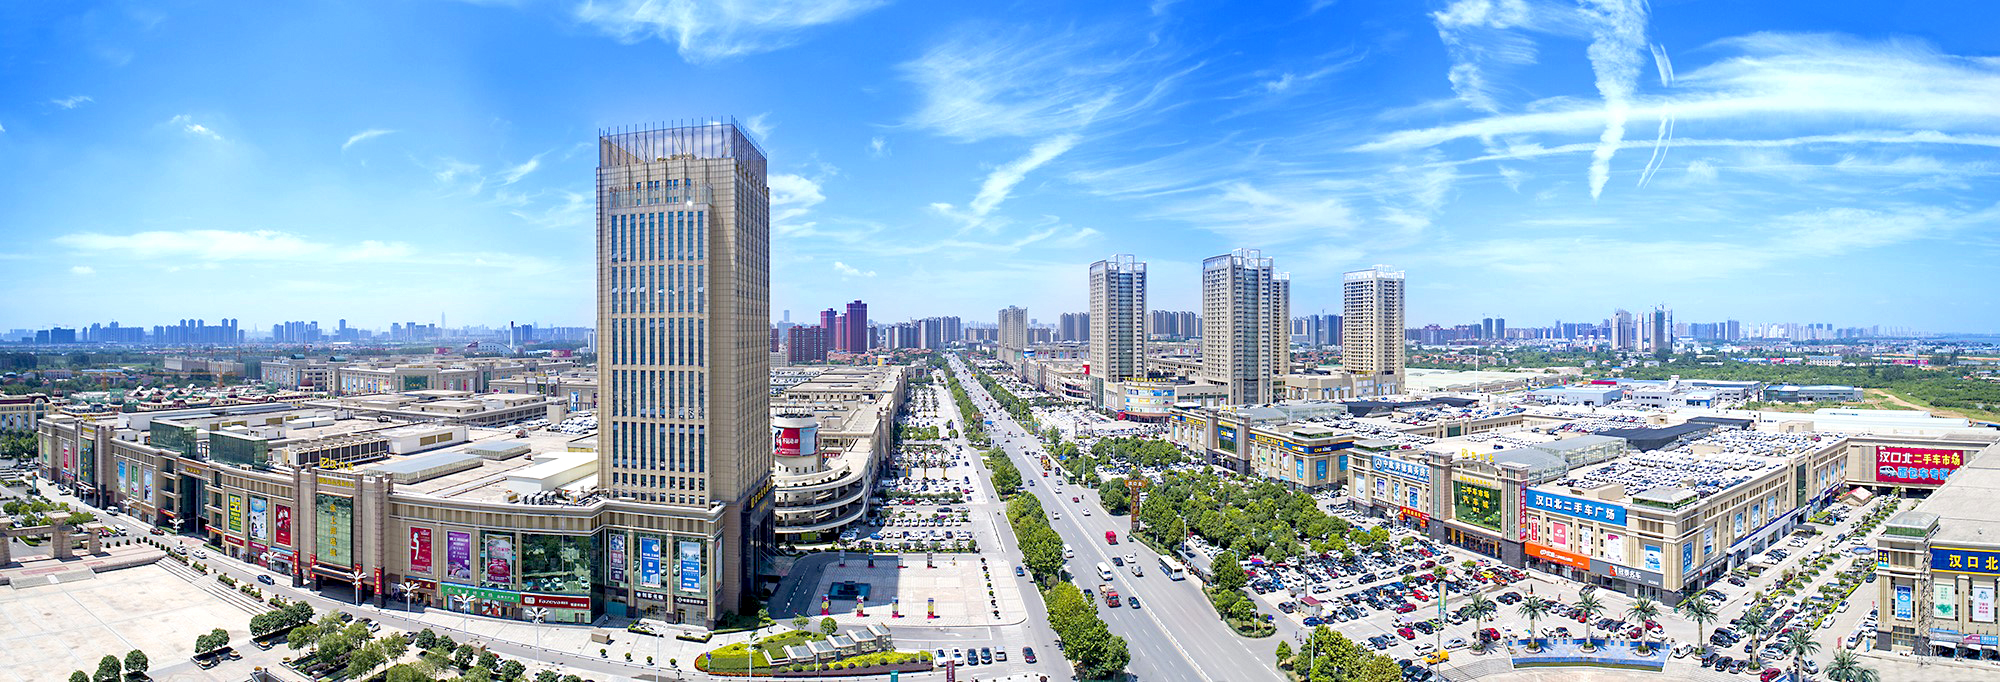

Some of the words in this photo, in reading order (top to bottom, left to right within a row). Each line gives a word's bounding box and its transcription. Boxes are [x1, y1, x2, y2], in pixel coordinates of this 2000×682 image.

[1879, 451, 1960, 466] 汉口北二手车市场
[1535, 494, 1615, 520] 汉口北二手车广场
[1949, 554, 1998, 570] 汉口北
